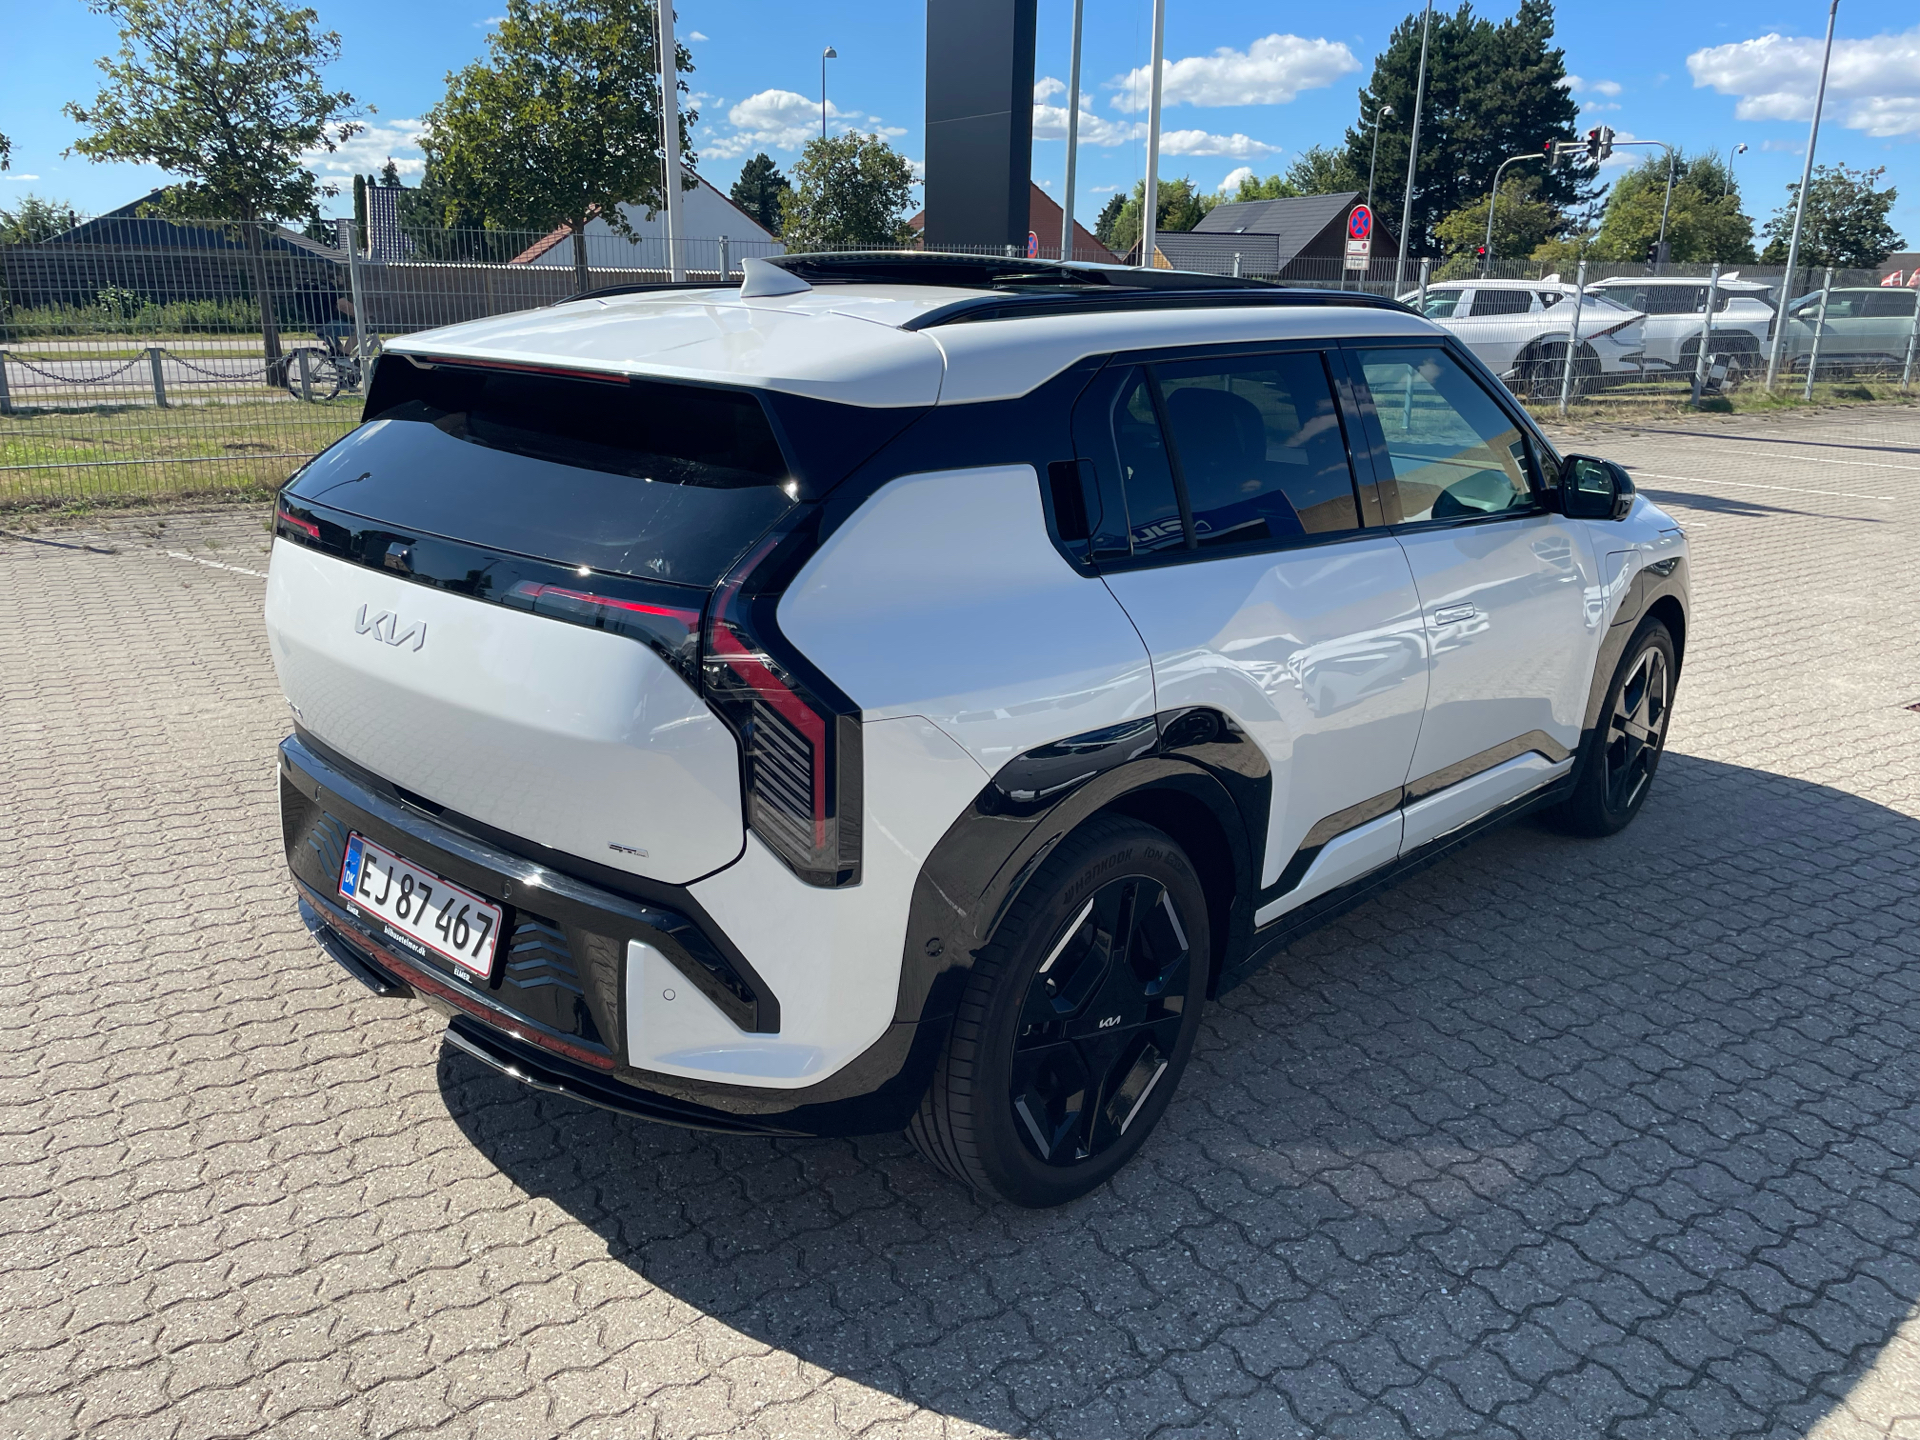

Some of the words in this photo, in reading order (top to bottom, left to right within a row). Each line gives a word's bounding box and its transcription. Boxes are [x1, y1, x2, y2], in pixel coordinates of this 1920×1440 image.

[354, 603, 427, 653] KIA
[345, 871, 355, 886] DK
[358, 853, 393, 906] EJ
[395, 873, 432, 926] 87
[435, 897, 493, 958] 467
[1098, 1015, 1121, 1028] KIA
